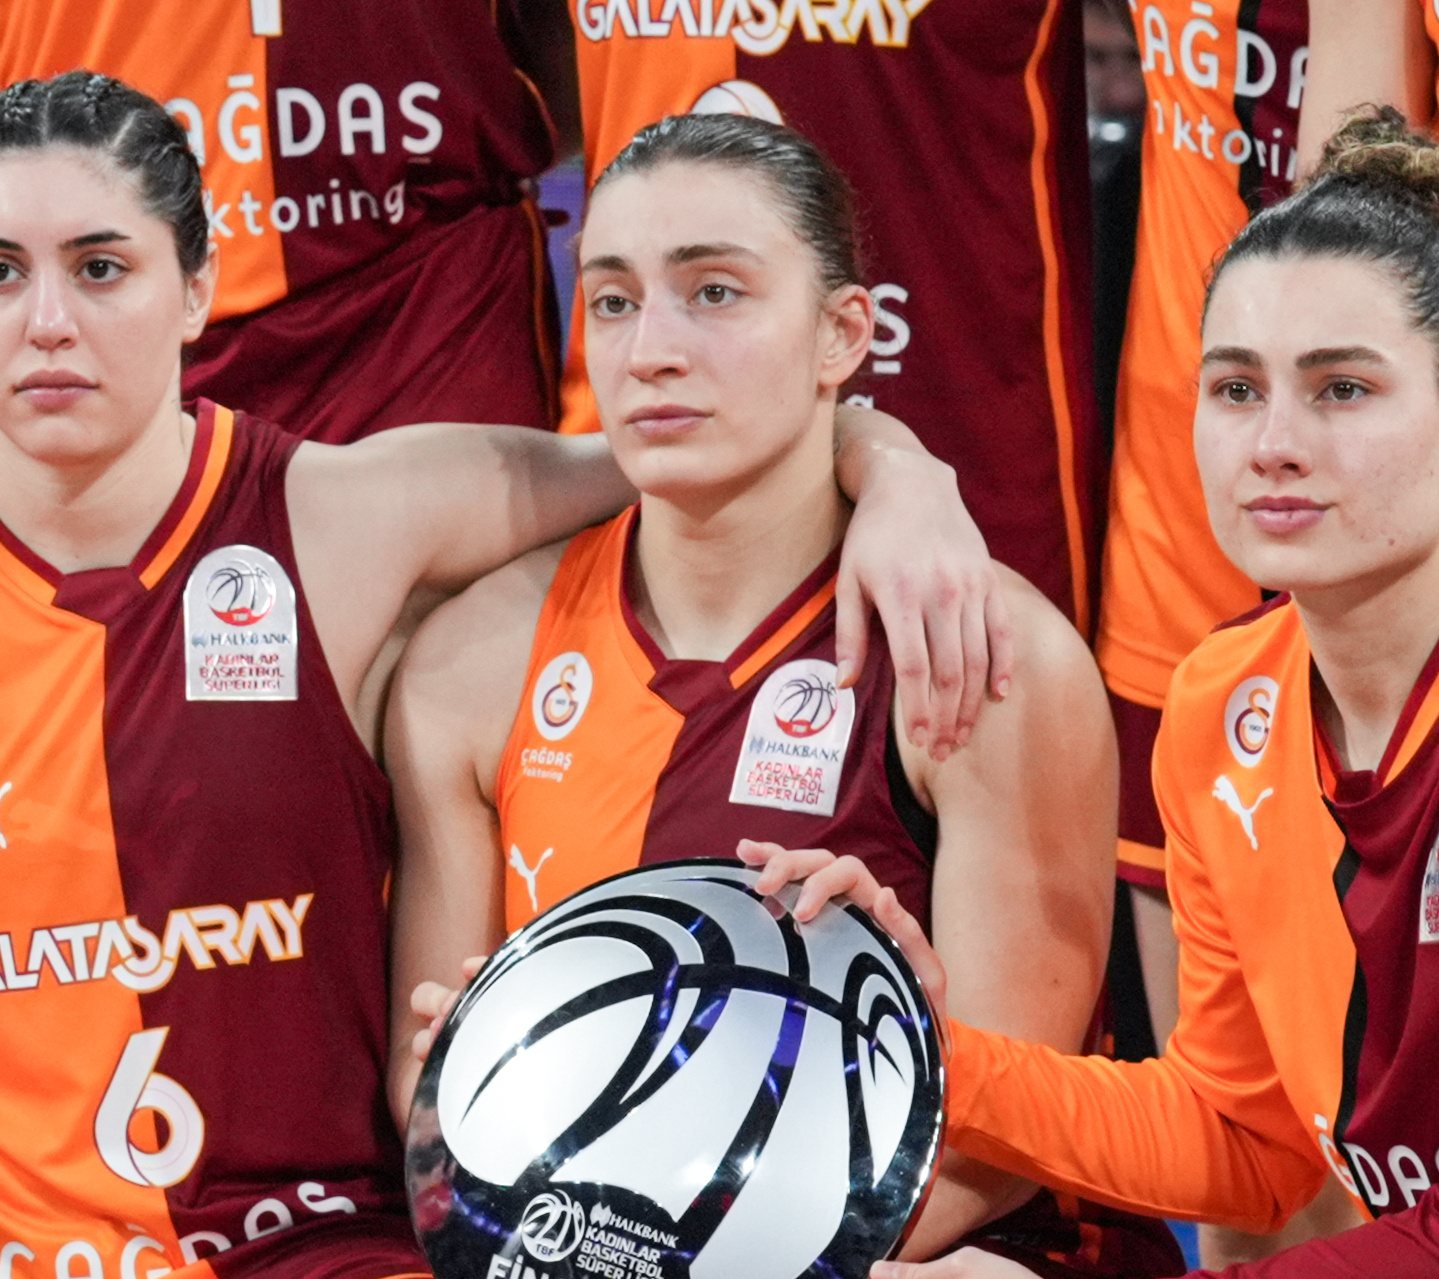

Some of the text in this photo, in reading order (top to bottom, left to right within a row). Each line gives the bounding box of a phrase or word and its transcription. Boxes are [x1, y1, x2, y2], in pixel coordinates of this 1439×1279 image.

[163, 74, 444, 164] AĞDAŞ
[207, 179, 406, 240] ktoring
[765, 739, 840, 763] HALKBANK
[747, 771, 825, 794] BASKETBOL
[755, 761, 824, 779] KADINLAR
[94, 1025, 205, 1188] 6
[585, 1226, 661, 1264] KADINLAR
[609, 1213, 679, 1249] HALKBANK
[535, 1243, 555, 1257] TBF
